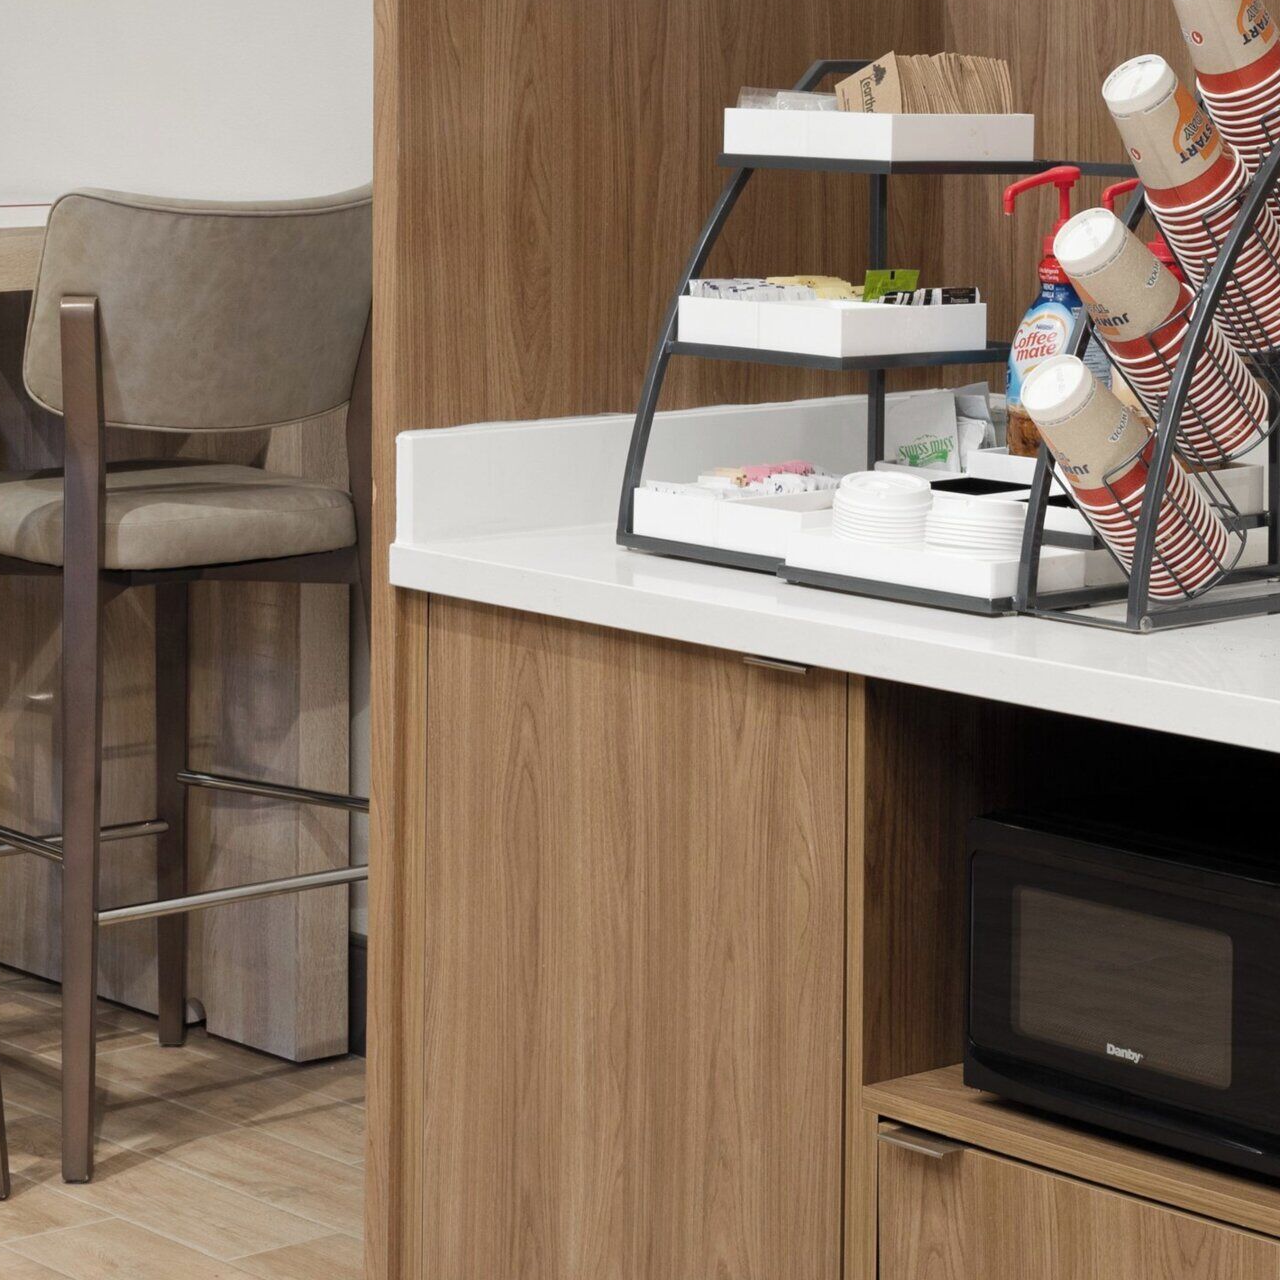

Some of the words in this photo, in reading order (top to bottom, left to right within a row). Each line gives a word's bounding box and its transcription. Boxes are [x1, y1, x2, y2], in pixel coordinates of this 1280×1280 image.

[1180, 123, 1213, 164] START
[1013, 329, 1058, 350] Coffee
[1016, 343, 1057, 362] mate
[1106, 1042, 1141, 1064] Danby
